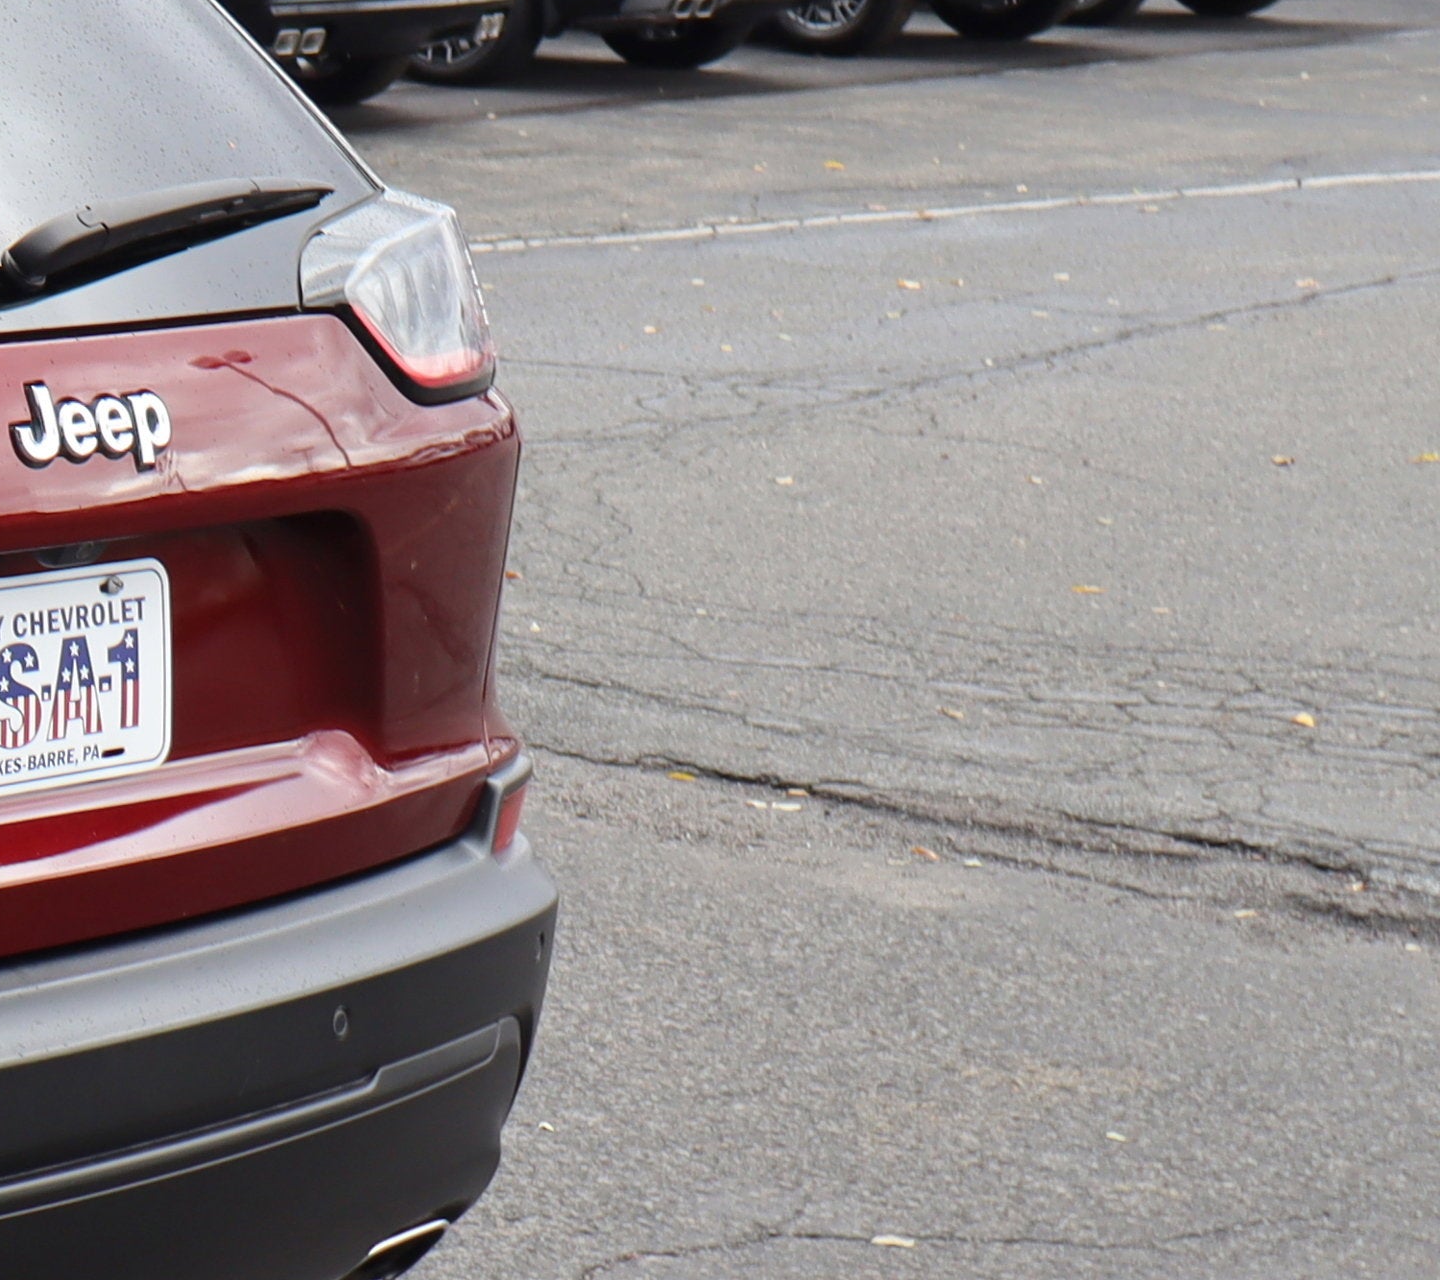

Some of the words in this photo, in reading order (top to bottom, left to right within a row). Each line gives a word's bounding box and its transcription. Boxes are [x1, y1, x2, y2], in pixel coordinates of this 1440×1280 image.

[9, 380, 173, 472] Jeep
[12, 596, 147, 640] CHEVROLET
[82, 744, 101, 762] PA
